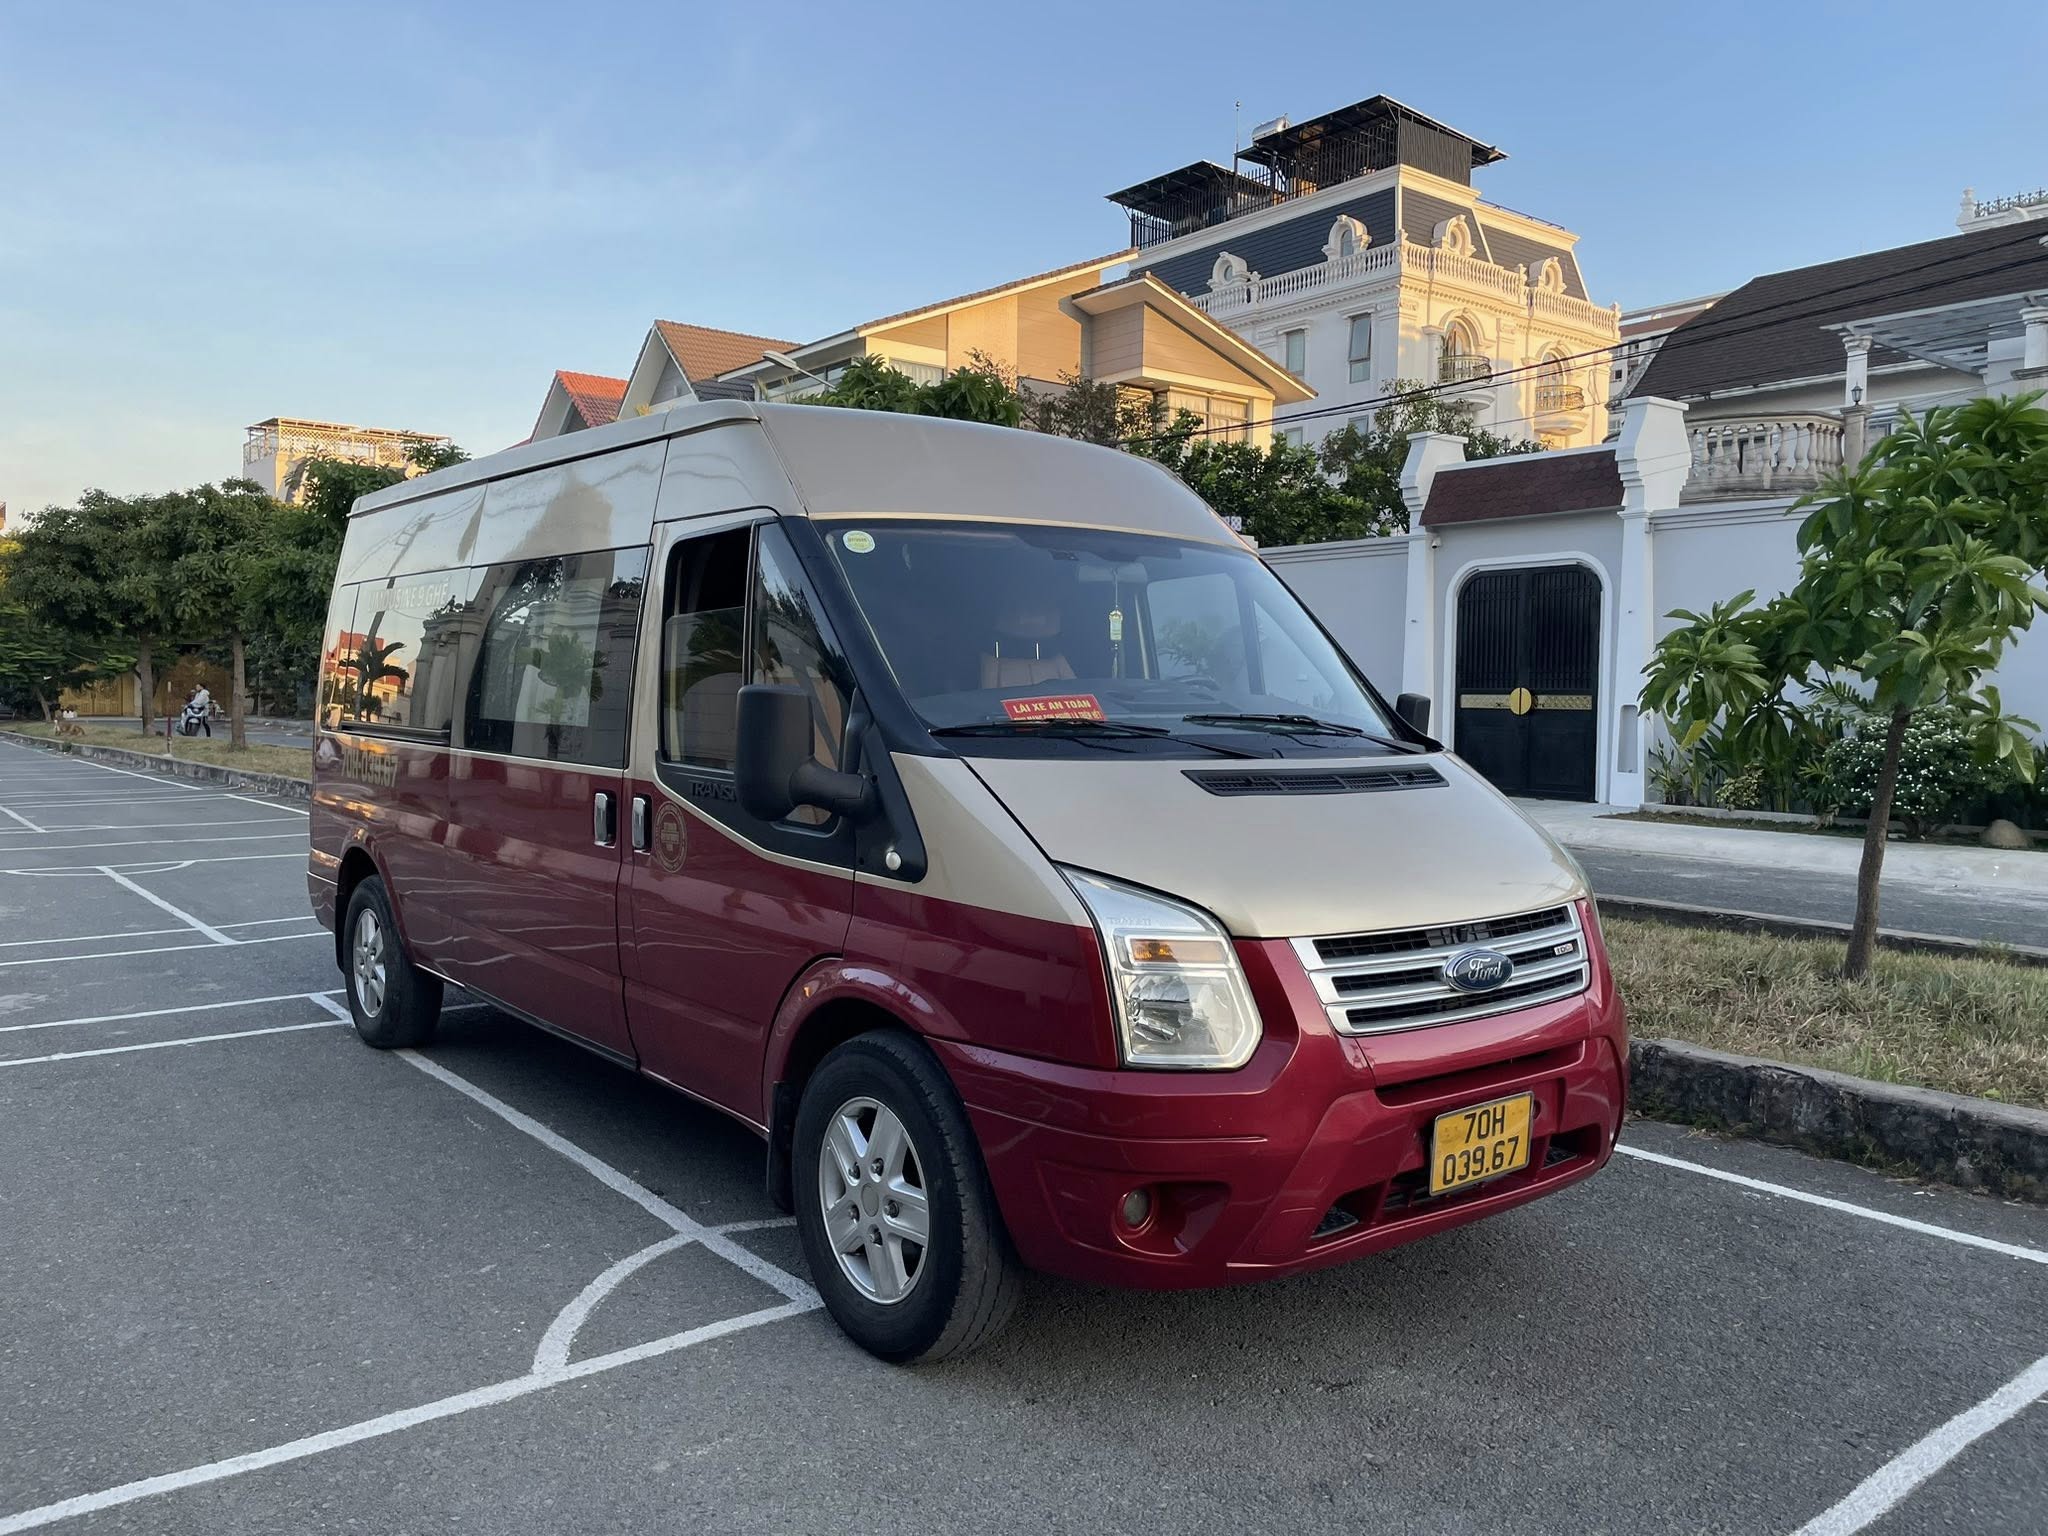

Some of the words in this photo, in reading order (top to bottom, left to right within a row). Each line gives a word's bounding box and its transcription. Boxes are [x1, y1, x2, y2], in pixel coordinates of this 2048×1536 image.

[1032, 702, 1047, 711] XE
[1048, 701, 1064, 710] AN
[341, 746, 399, 788] 70H-039.67
[688, 779, 737, 803] TRANSI
[1467, 957, 1503, 981] Ford
[1463, 1105, 1506, 1144] 70H
[1442, 1136, 1519, 1186] 039.67
